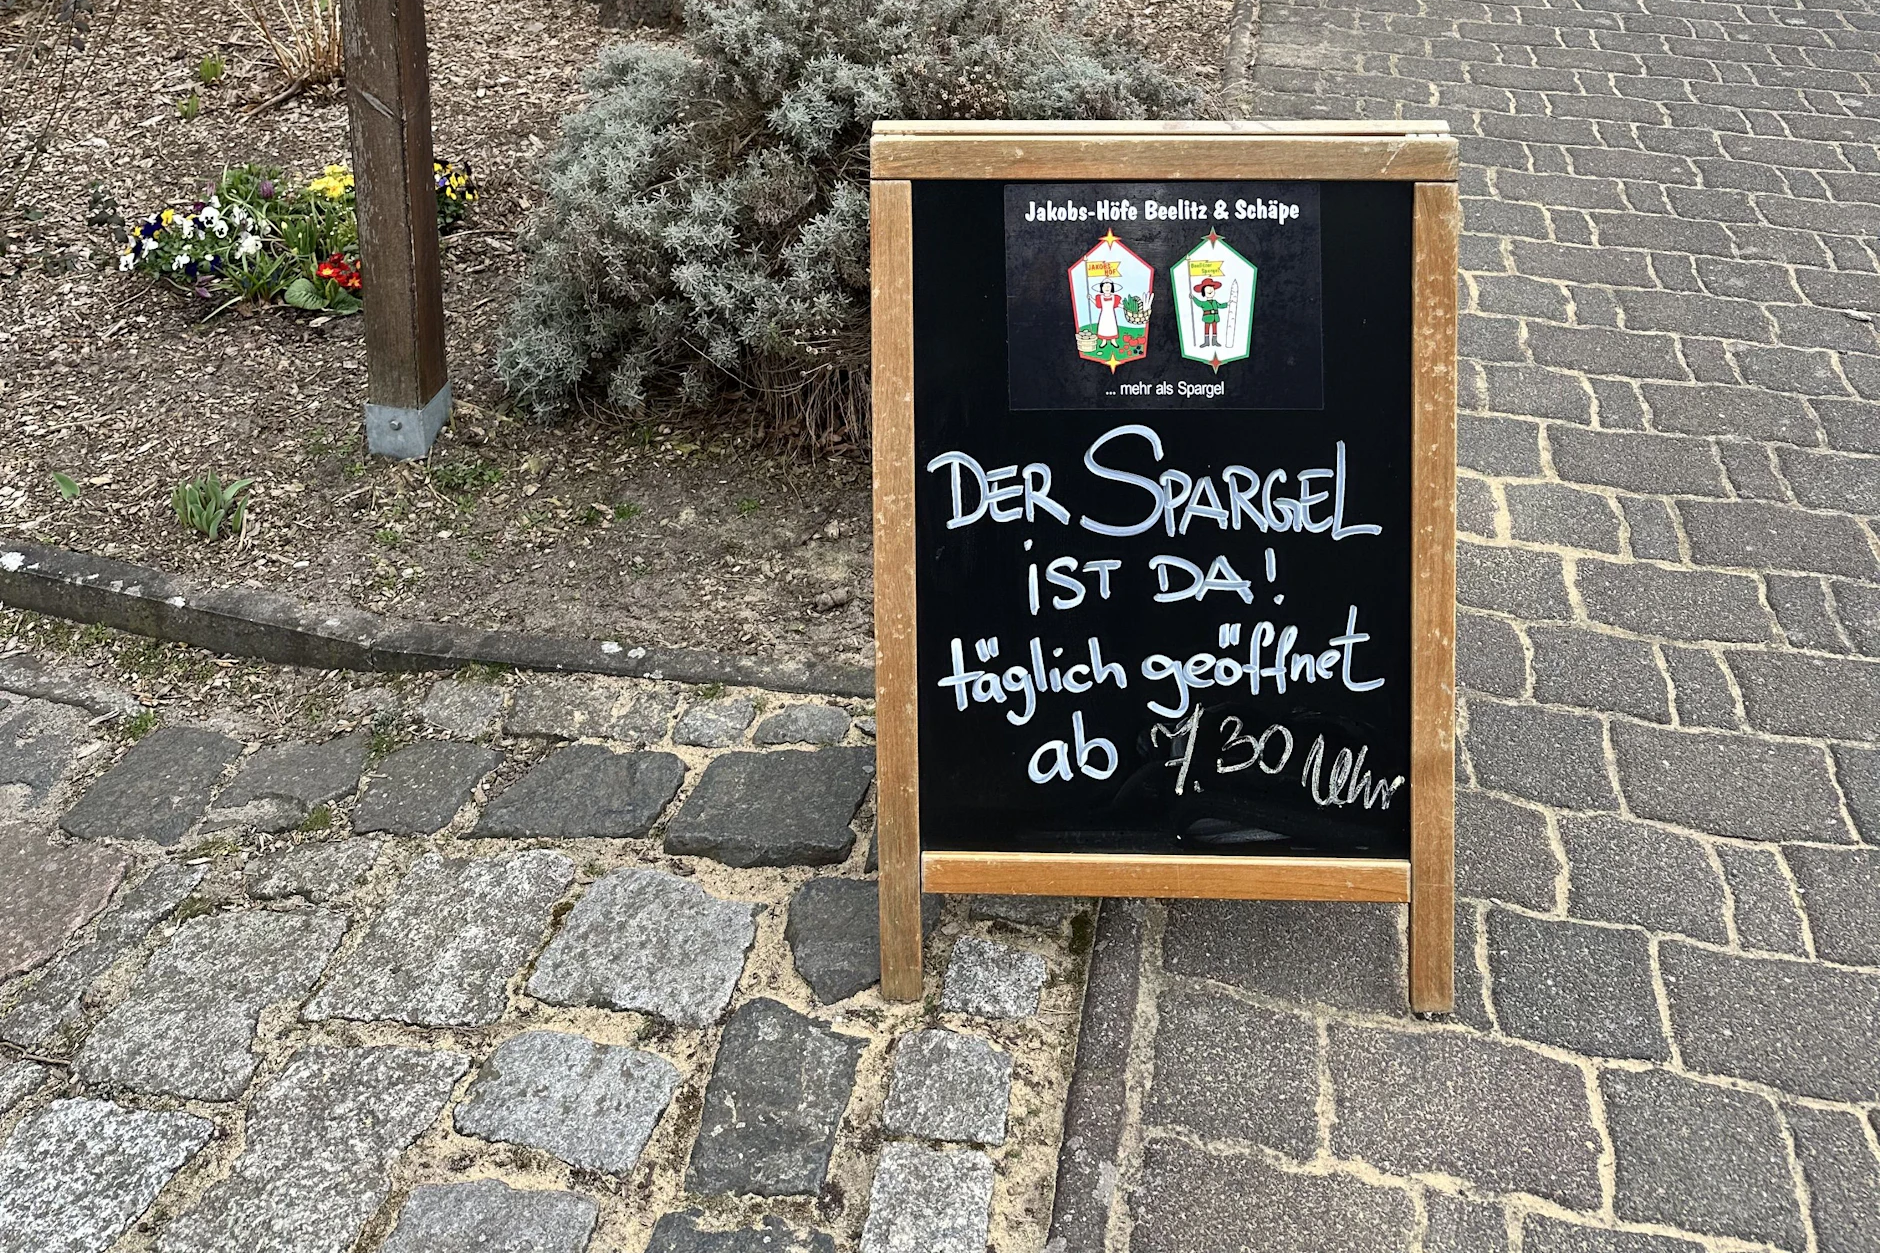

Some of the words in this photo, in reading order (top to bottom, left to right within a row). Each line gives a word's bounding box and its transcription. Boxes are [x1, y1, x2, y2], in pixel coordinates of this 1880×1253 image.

[1024, 199, 1138, 222] Jakobs-Höfe
[1144, 199, 1208, 220] Beelitz
[1213, 199, 1229, 220] &
[1234, 198, 1300, 225] Schäpe
[1120, 381, 1152, 395] mehr
[1155, 381, 1174, 395] als
[1178, 381, 1225, 398] Spargel
[926, 450, 1070, 530] DER
[1152, 547, 1285, 606] DA!
[938, 637, 1127, 727] täglich
[1140, 604, 1385, 720] geöffnet
[1027, 710, 1119, 783] ab
